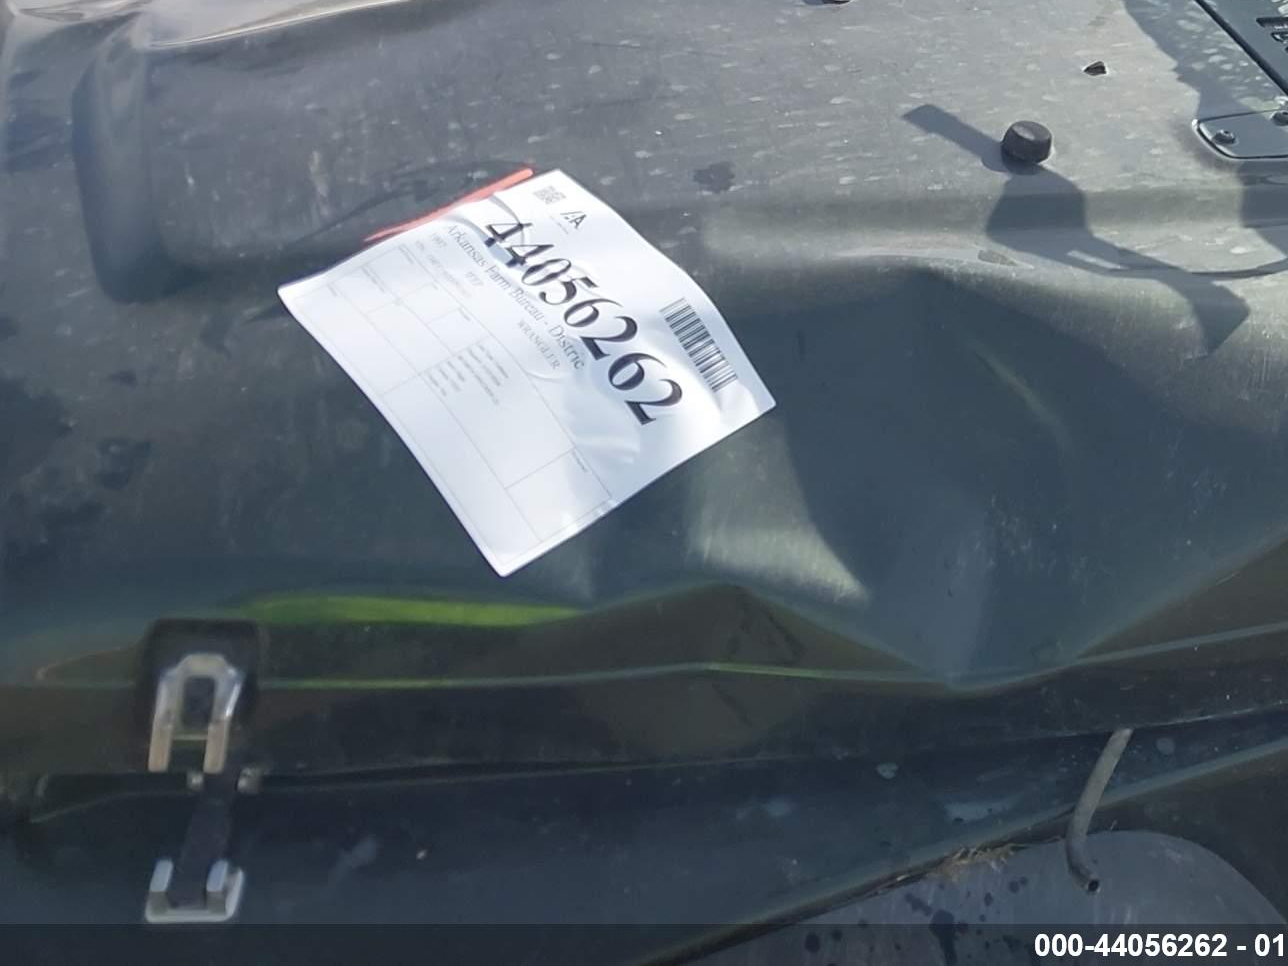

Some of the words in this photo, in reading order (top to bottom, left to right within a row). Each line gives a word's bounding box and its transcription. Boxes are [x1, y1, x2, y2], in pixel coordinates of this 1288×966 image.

[448, 225, 490, 267] Arkansas
[485, 261, 514, 295] Farm
[511, 286, 545, 322] Bureau
[548, 323, 585, 370] Distric
[484, 222, 684, 425] 44056262
